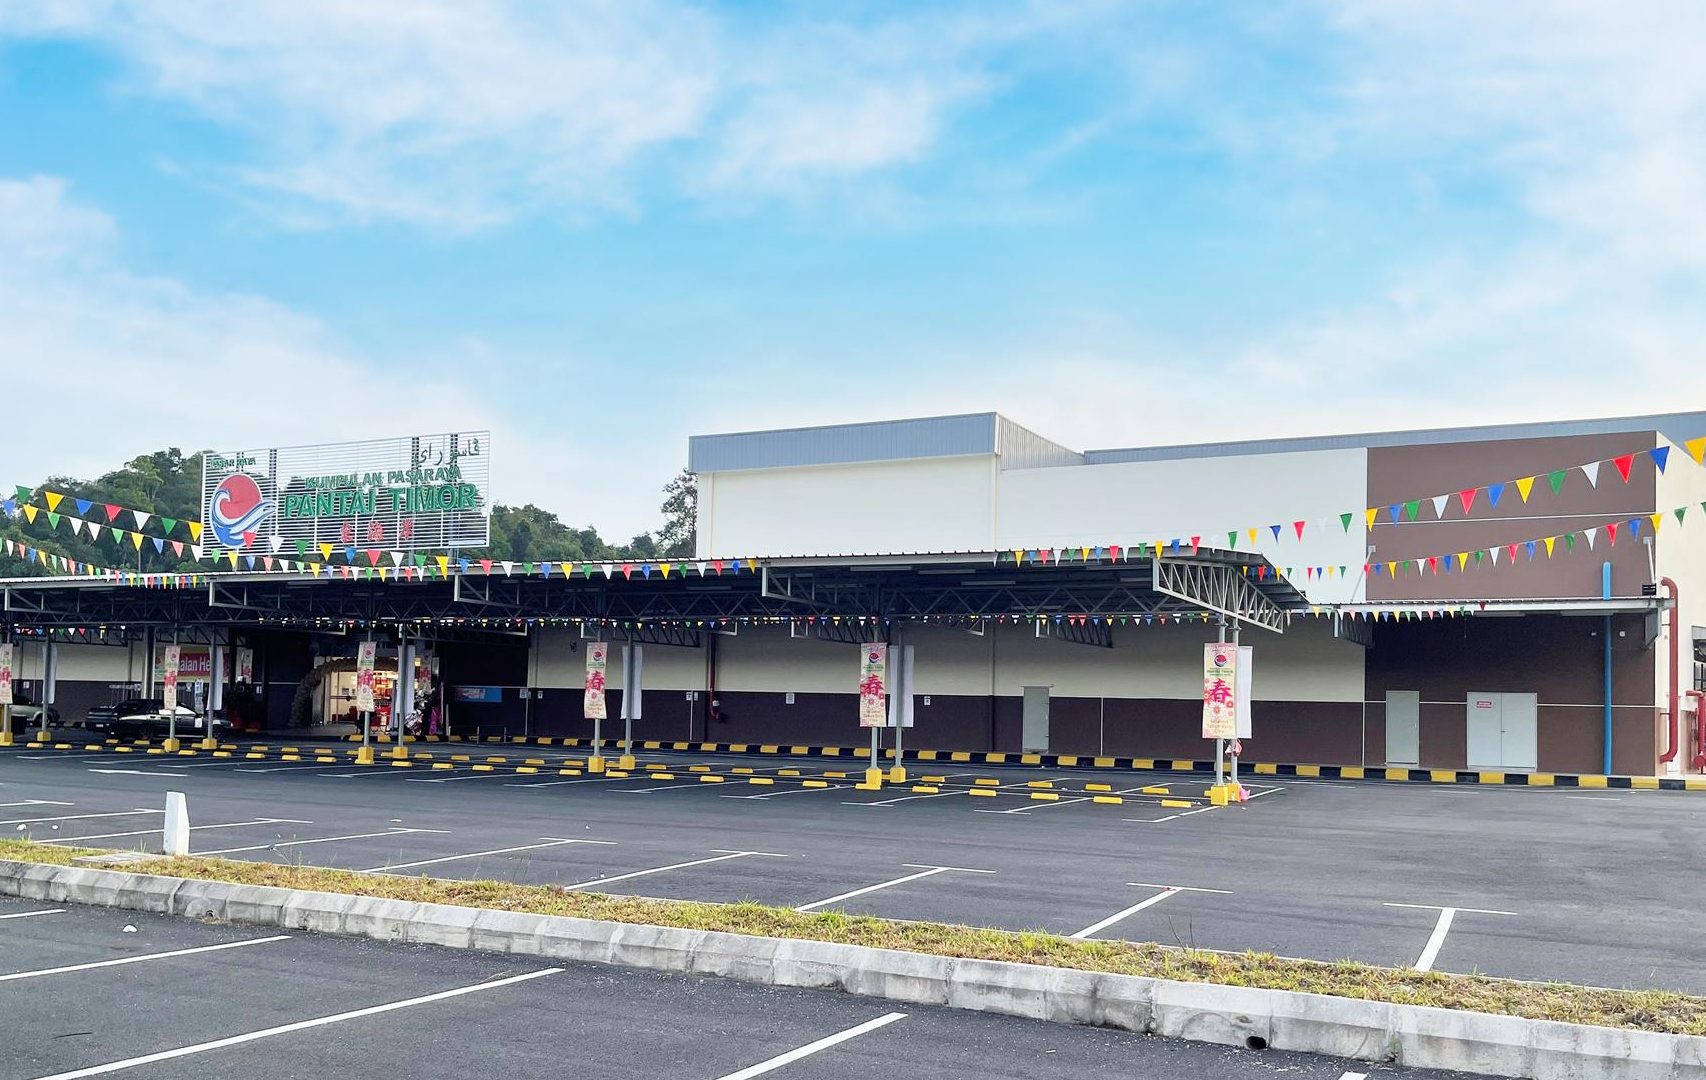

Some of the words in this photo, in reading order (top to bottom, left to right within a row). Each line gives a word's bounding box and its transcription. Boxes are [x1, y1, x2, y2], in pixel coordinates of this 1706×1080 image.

[305, 471, 383, 489] KUMPULAN
[387, 465, 462, 483] PASARAYA
[284, 486, 376, 518] PANTAI
[388, 483, 477, 512] TIMOR
[865, 674, 883, 696] 春
[1211, 678, 1232, 703] 春
